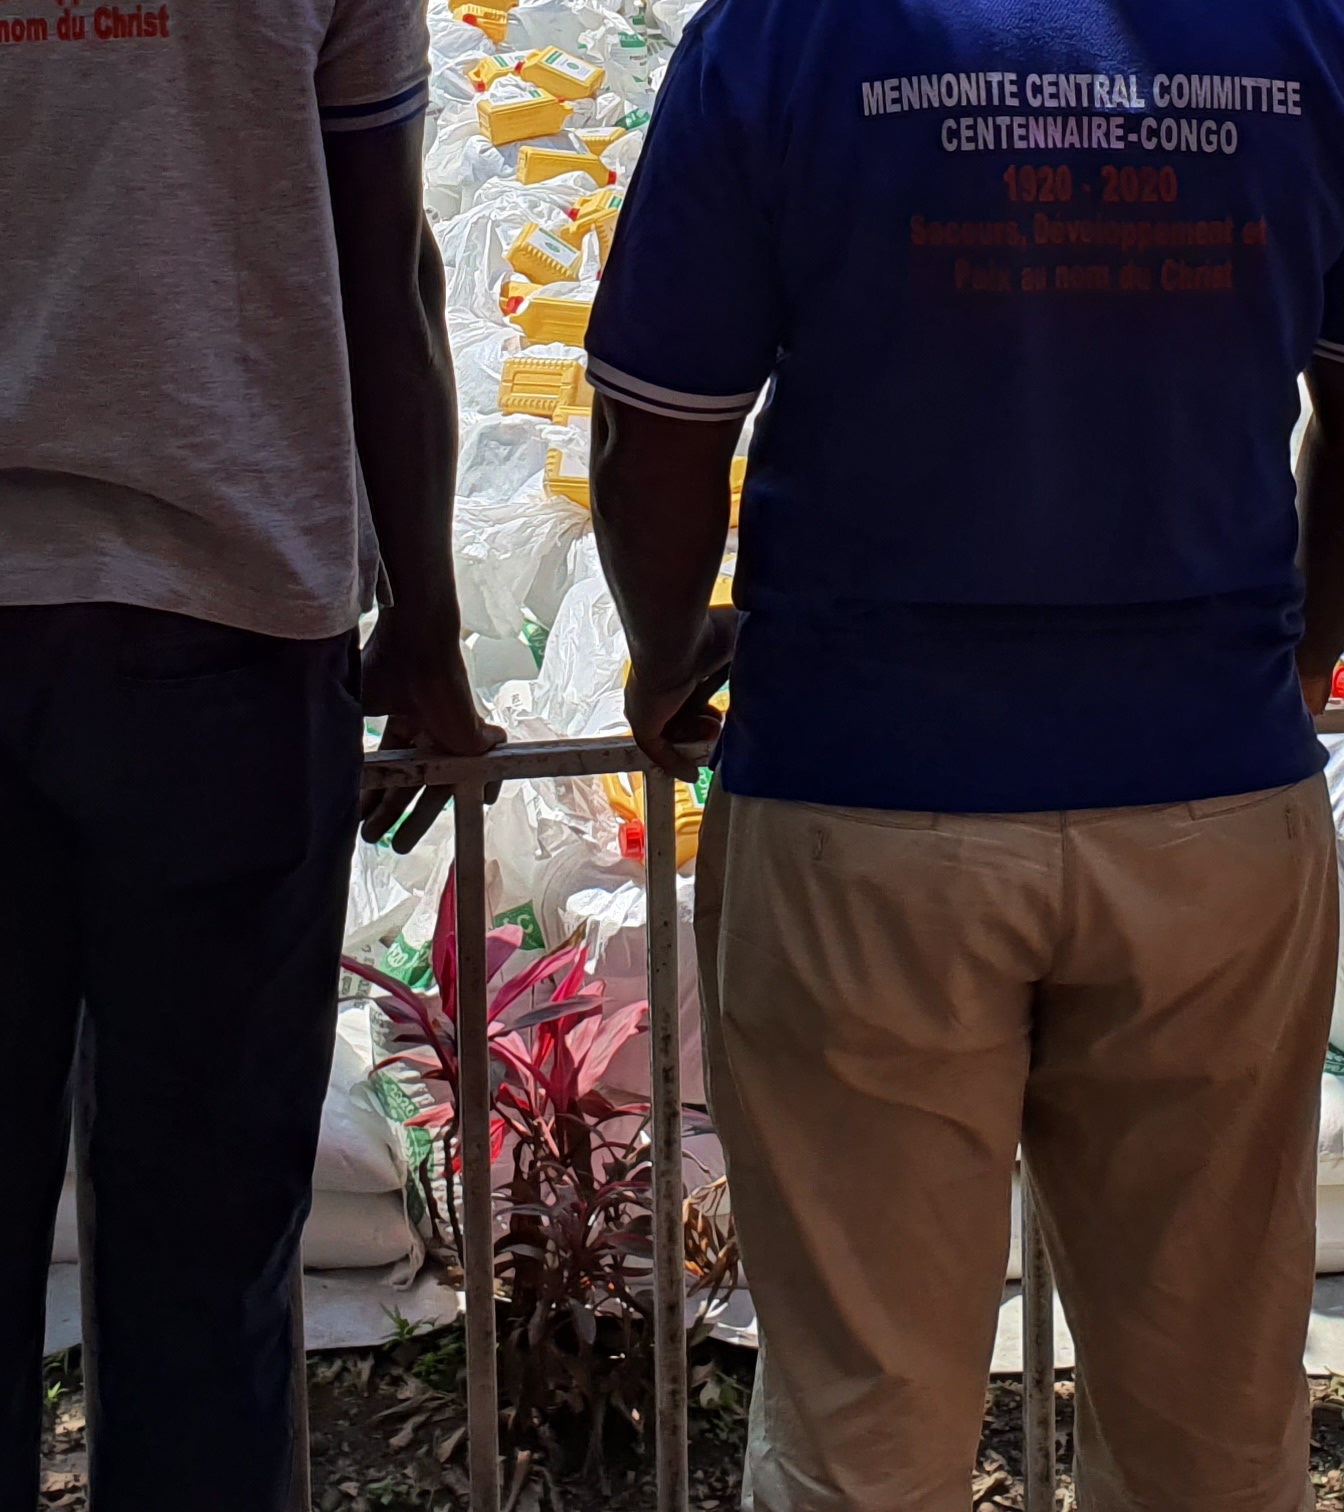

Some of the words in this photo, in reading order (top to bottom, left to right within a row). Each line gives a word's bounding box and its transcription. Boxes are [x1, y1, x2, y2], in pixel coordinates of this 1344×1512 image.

[57, 8, 84, 41] du
[93, 5, 170, 40] Christ
[862, 71, 1019, 116] MENNONITE
[1026, 73, 1145, 108] CENTRAL
[1153, 73, 1302, 116] COMMITTEE
[941, 116, 1238, 155] CENTENNAIRE-CONGO
[1003, 164, 1072, 203] 1920
[1101, 164, 1178, 203] 2020
